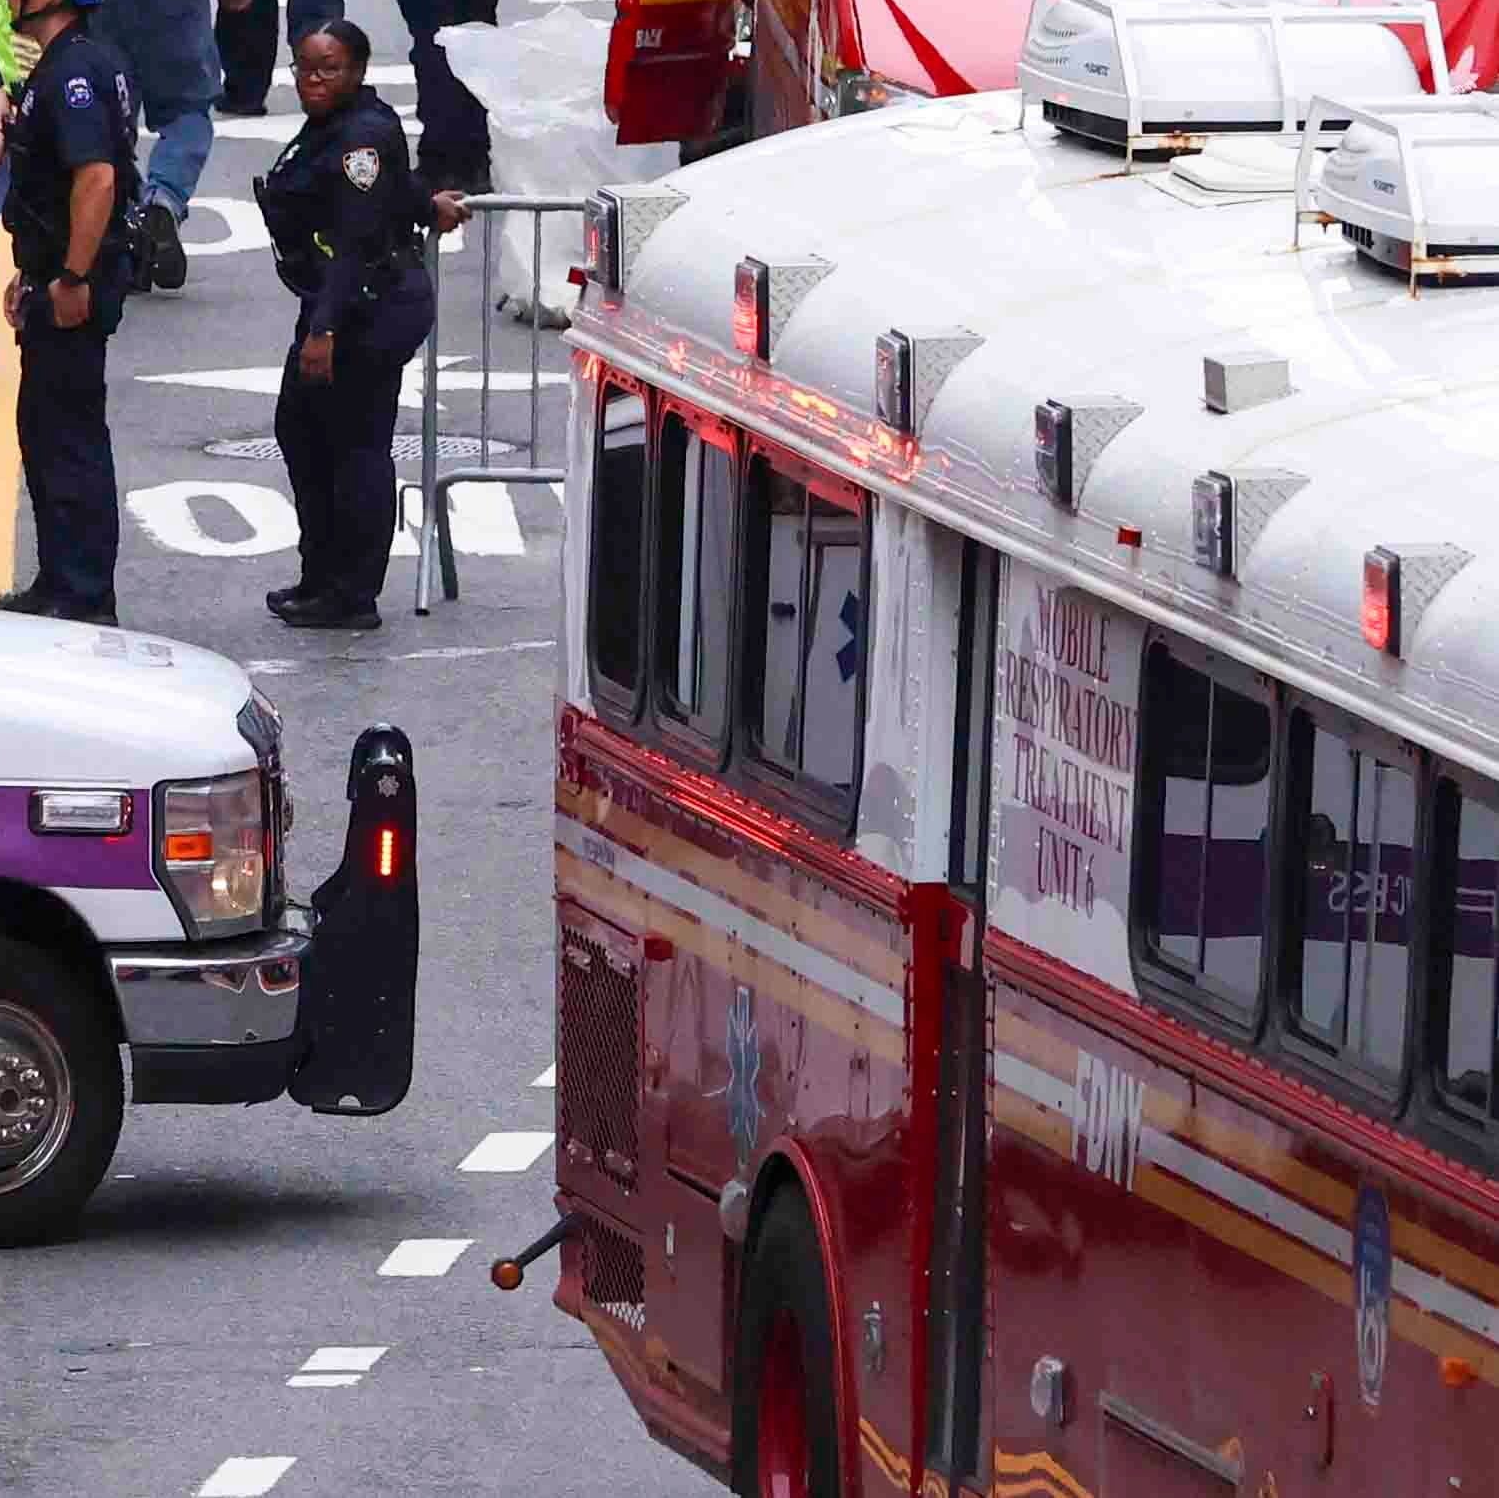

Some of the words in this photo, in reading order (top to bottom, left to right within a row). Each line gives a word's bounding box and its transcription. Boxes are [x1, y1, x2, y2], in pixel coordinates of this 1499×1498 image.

[1037, 581, 1110, 684] MOBILE
[1005, 649, 1139, 773] RESPIRATORY
[1013, 732, 1128, 853] TREATMENT
[1037, 825, 1082, 912] UNIT
[1084, 853, 1095, 916] 6
[1069, 1046, 1146, 1192] FDNY
